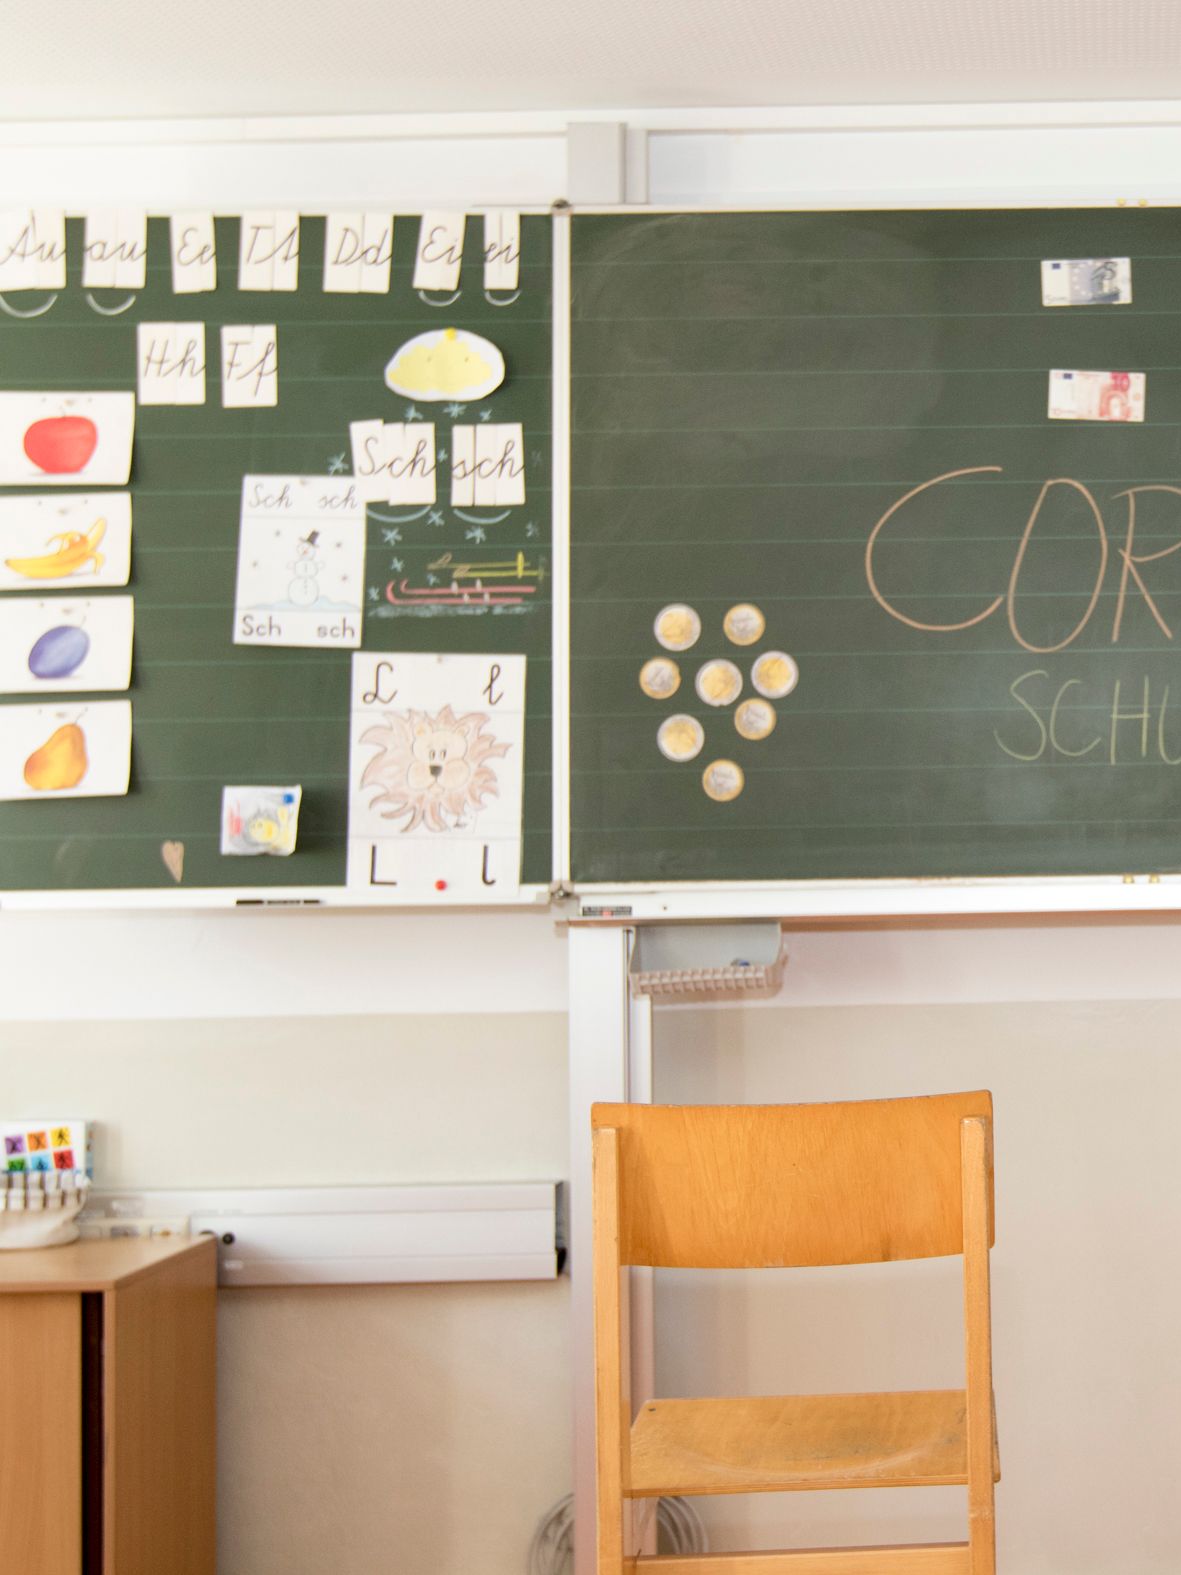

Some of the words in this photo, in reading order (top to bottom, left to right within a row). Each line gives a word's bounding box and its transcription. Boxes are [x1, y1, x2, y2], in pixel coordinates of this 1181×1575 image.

[84, 239, 147, 262] au
[177, 227, 216, 266] Ee
[332, 227, 392, 266] Dd
[421, 225, 463, 265] Ei
[144, 339, 206, 378] Hh
[358, 436, 437, 478] Sch
[453, 439, 525, 480] sch
[249, 482, 293, 509] Sch
[319, 485, 358, 509] sch
[242, 614, 282, 637] Sch
[316, 616, 355, 638] sch
[362, 661, 398, 704] L
[370, 845, 397, 886] L
